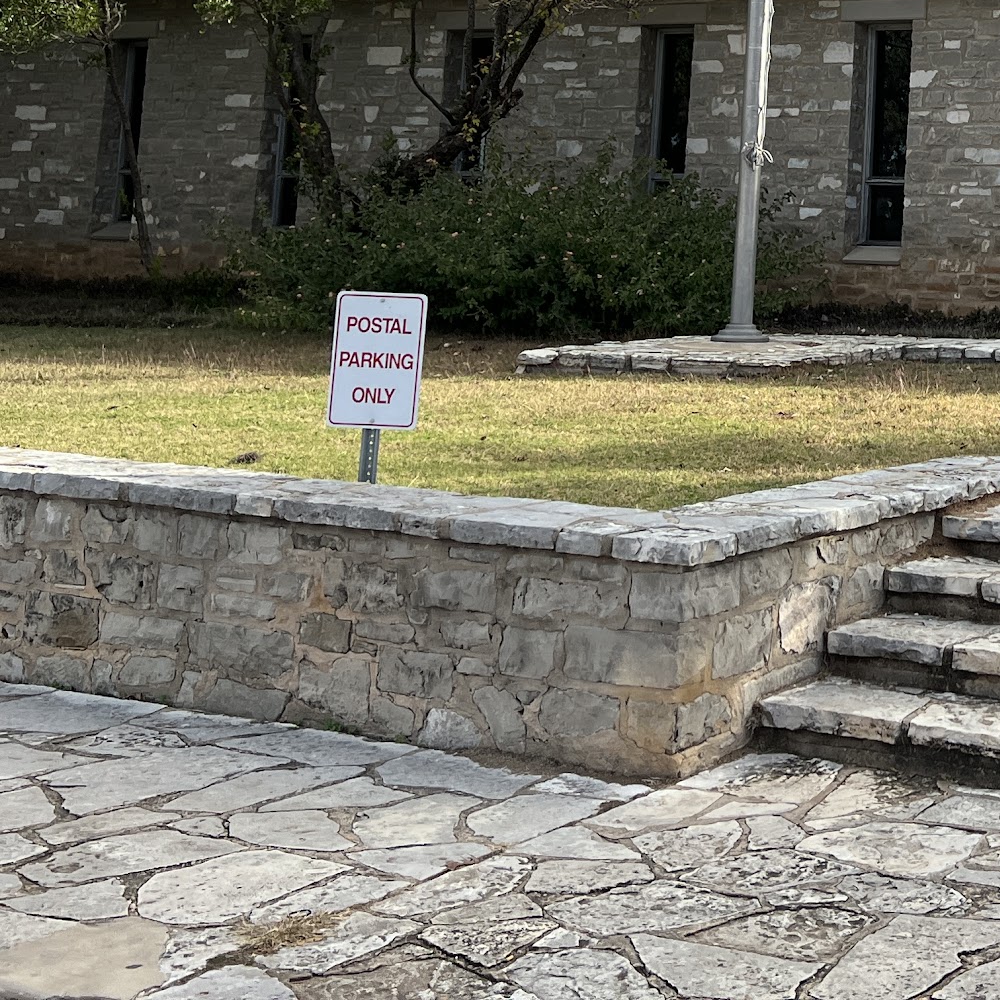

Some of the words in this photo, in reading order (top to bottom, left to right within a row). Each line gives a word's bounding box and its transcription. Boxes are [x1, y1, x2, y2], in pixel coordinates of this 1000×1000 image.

[346, 316, 412, 335] POSTAL
[339, 351, 414, 370] PARKING
[352, 386, 396, 404] ONLY
